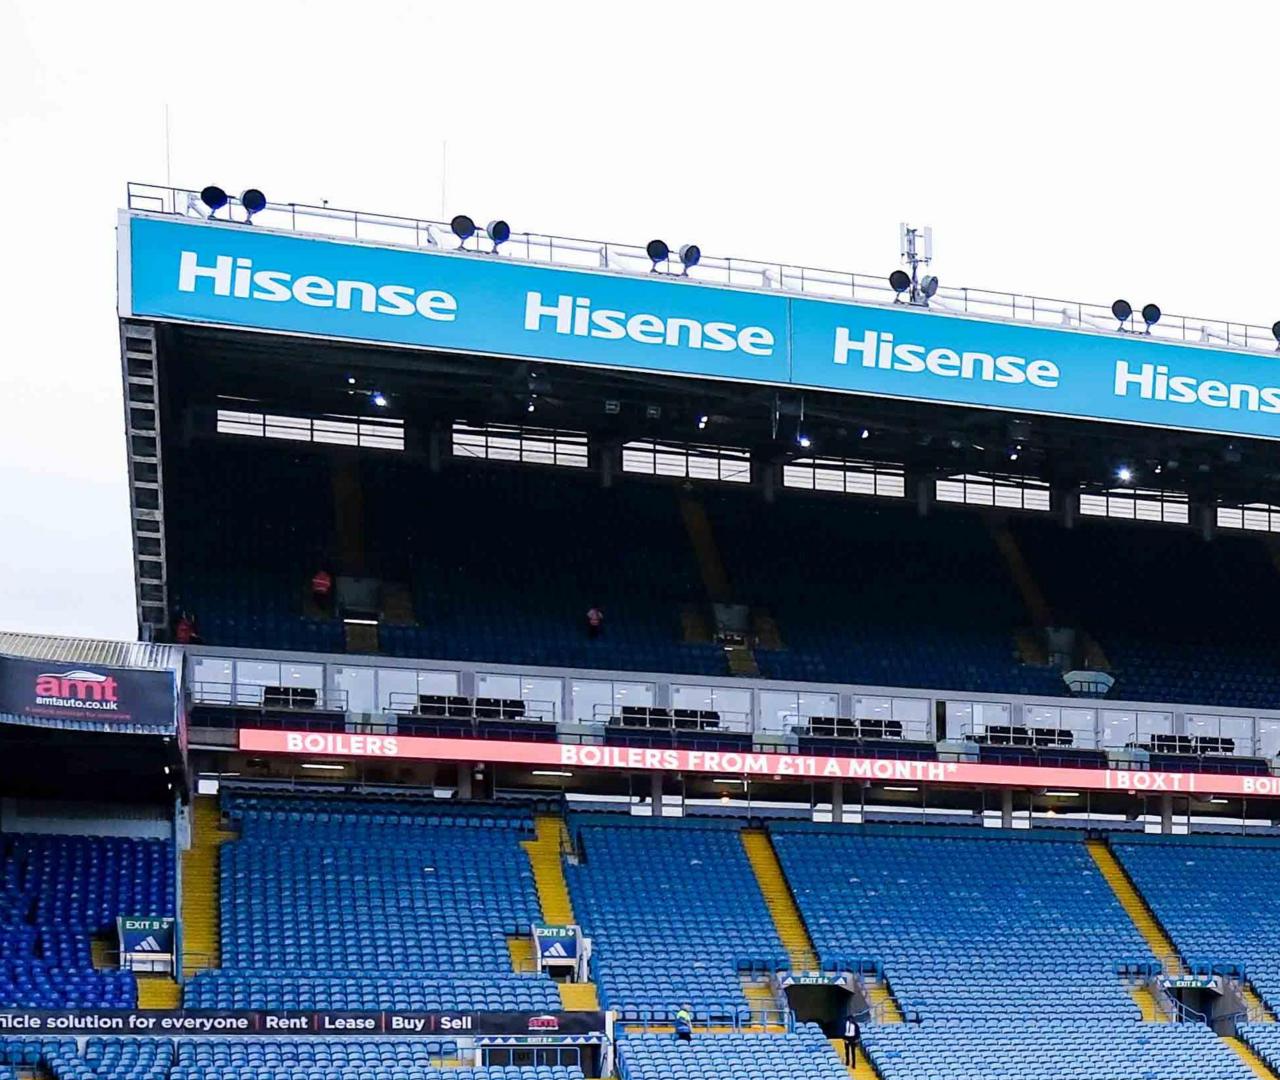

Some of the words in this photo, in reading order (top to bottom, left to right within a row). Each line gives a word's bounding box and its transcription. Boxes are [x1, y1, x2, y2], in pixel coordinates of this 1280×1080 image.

[178, 251, 457, 321] Hisense
[525, 292, 774, 355] Hisense
[833, 327, 1059, 388] Hisense
[35, 676, 118, 700] amt
[36, 696, 118, 710] amtauto.co.uk
[287, 733, 398, 755] BOILERS
[561, 745, 679, 769] BOILERS
[688, 750, 768, 773] FROM
[777, 755, 817, 775] £11
[823, 757, 842, 777] A
[126, 921, 151, 929] EXIT
[537, 928, 559, 936] EXIT
[47, 1014, 123, 1029] solution
[129, 1014, 156, 1029] for
[161, 1016, 248, 1031] everyone
[266, 1016, 308, 1029] Rent
[324, 1016, 375, 1030] Lease
[392, 1017, 425, 1032] Buy
[440, 1016, 472, 1030] Sell
